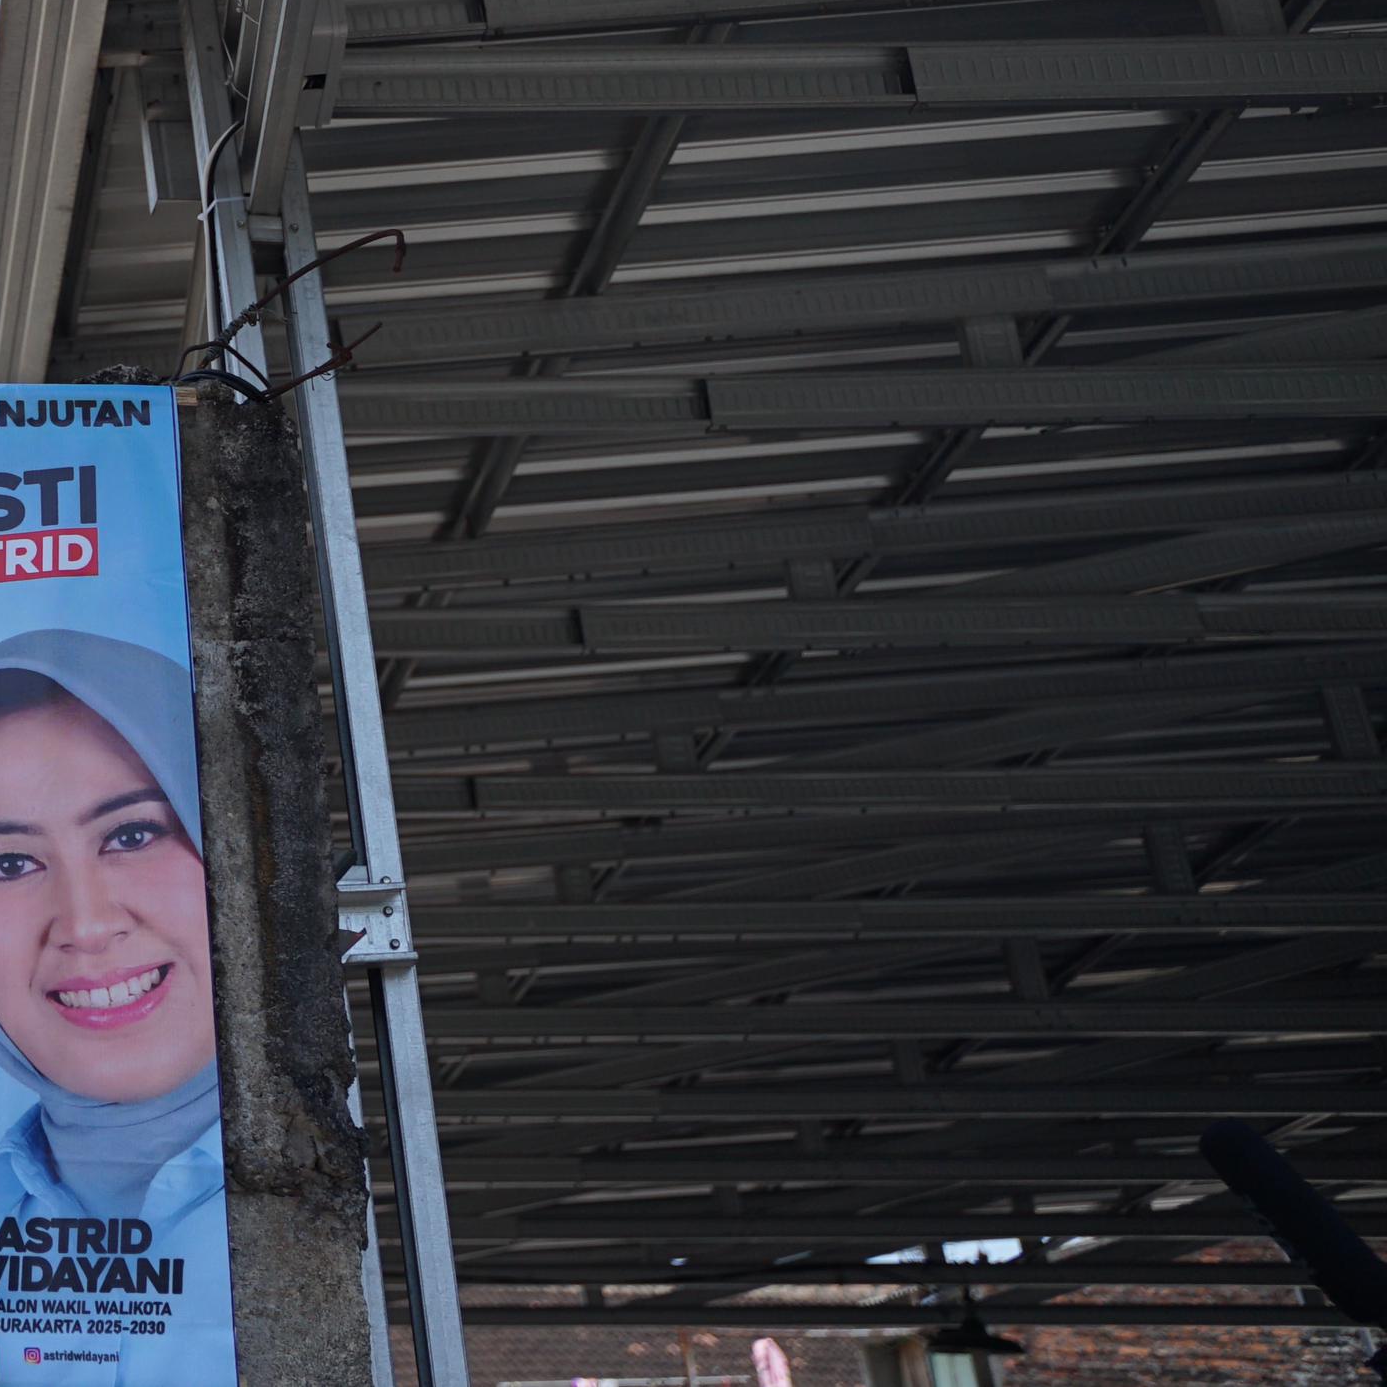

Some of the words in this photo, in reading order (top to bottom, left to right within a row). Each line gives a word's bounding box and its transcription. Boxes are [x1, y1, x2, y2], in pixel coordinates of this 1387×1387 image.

[41, 1300, 91, 1314] WAKIL
[95, 1301, 172, 1316] WALIKOTA
[87, 1319, 165, 1334] 2025-2030
[44, 1351, 119, 1364] astridwidayani
